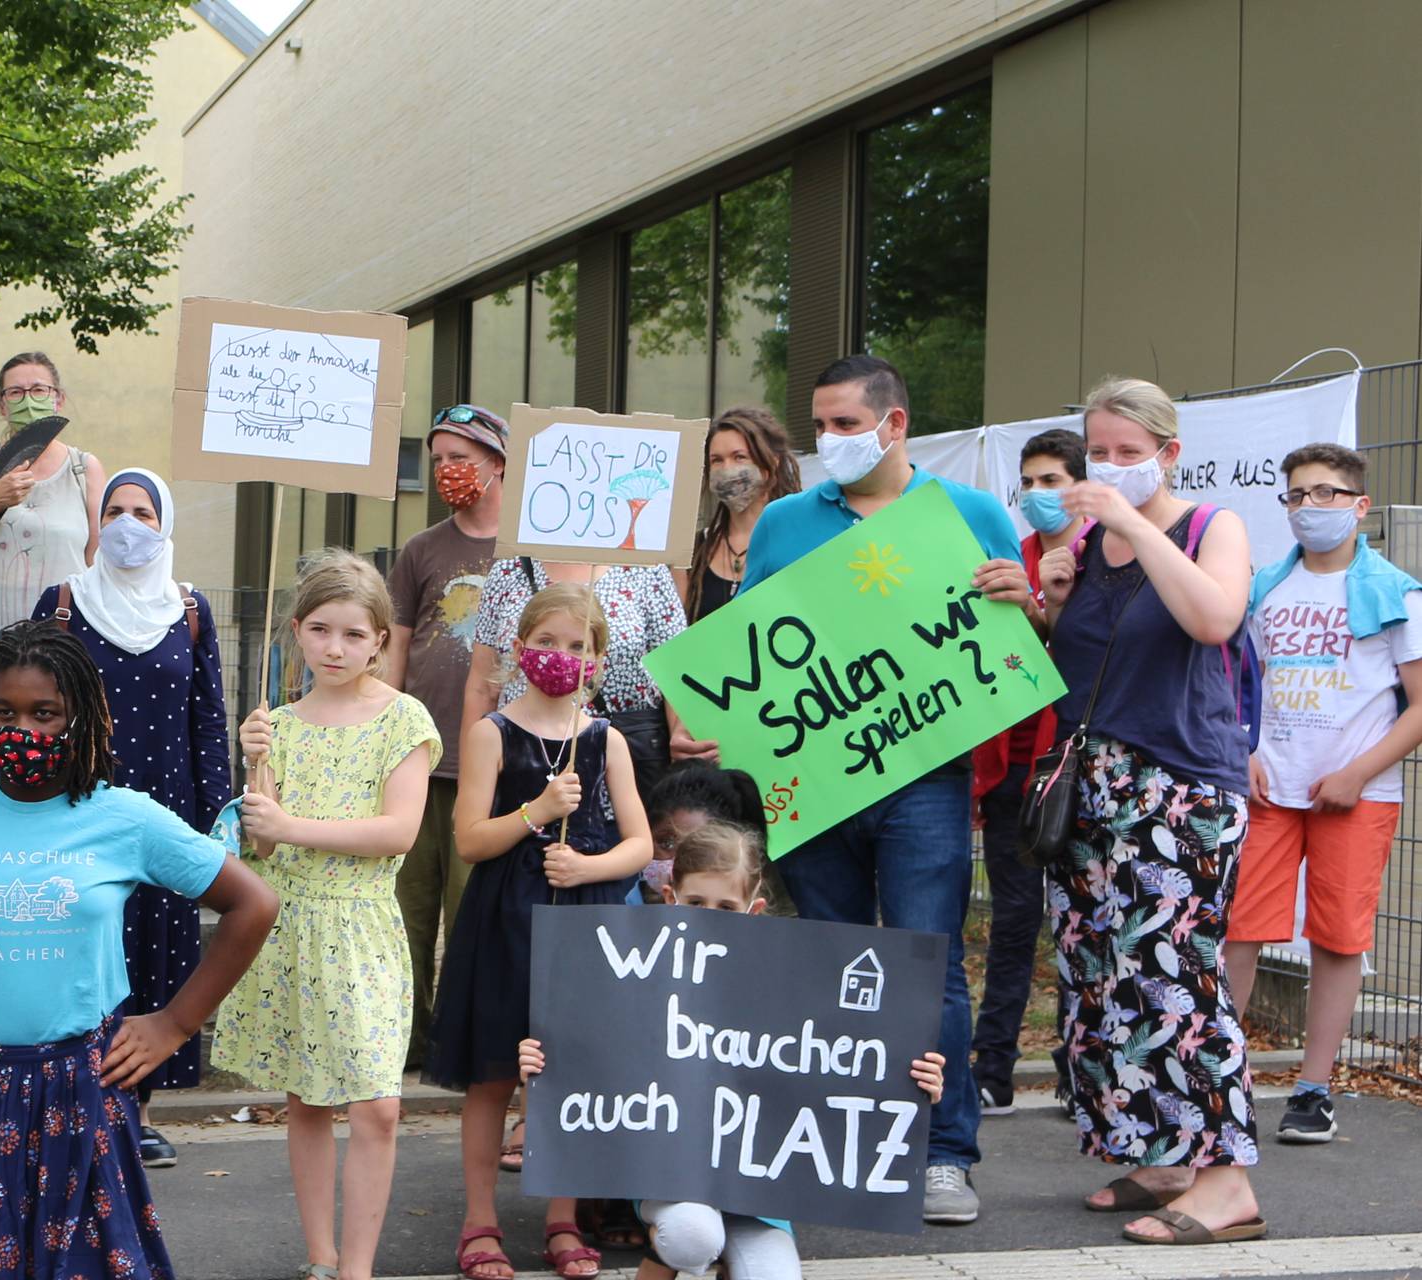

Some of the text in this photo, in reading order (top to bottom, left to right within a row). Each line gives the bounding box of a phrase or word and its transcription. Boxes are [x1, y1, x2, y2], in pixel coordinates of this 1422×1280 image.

[226, 336, 271, 358] Lasst
[279, 341, 302, 363] der
[269, 368, 316, 394] OGS
[298, 400, 352, 425] OGS
[531, 435, 668, 485] LASST Die
[1170, 458, 1277, 490] EHLER AUS
[910, 586, 984, 650] wir
[959, 640, 997, 696] ?
[1268, 668, 1354, 691] STIVAL
[1272, 690, 1322, 711] OUR
[596, 922, 728, 984] Wir
[667, 993, 887, 1082] brauchen
[559, 1082, 919, 1193] auch PLATZ
